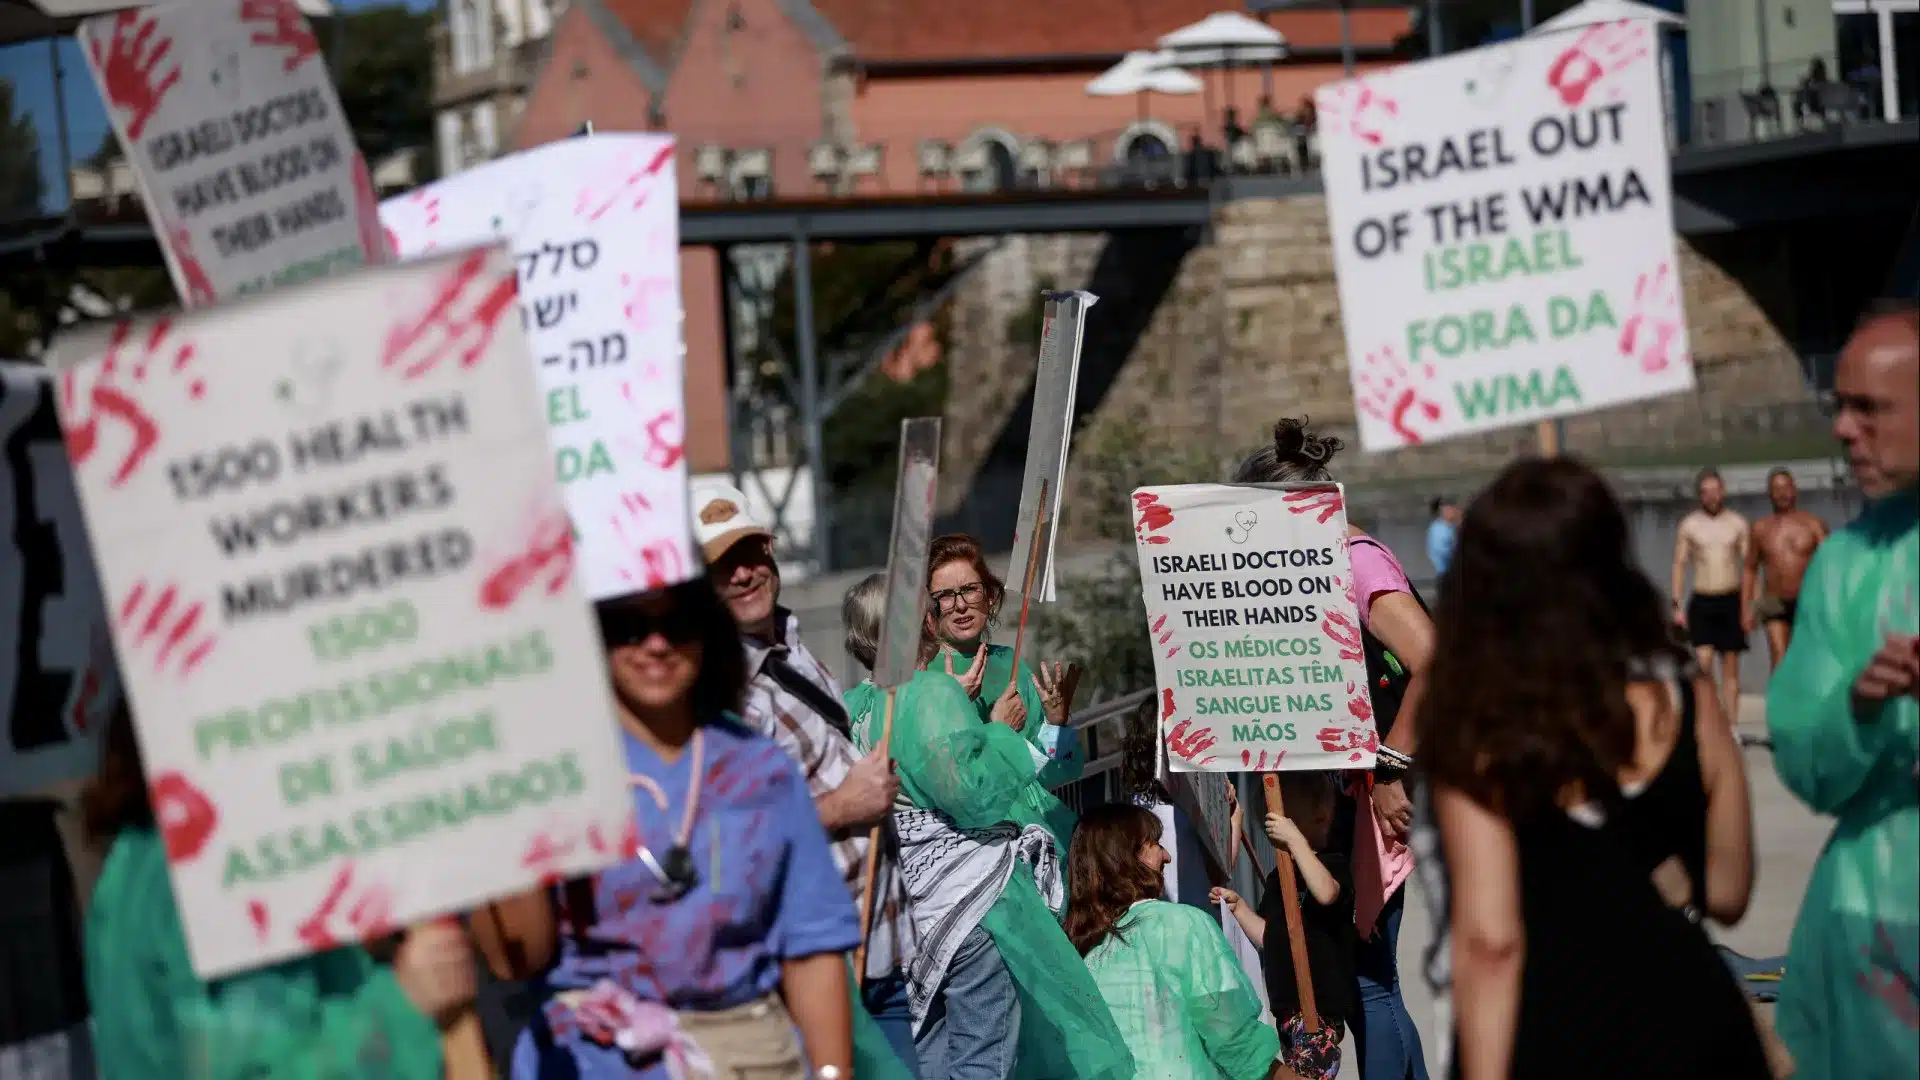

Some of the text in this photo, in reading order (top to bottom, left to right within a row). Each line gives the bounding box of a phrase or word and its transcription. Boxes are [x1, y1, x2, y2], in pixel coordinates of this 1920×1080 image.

[1360, 104, 1627, 192] ISRAEL OUT
[1353, 169, 1652, 260] OF THE WMA
[1423, 230, 1584, 293] ISRAEL
[1406, 291, 1617, 363] FORA DA
[1452, 366, 1583, 421] WMA
[165, 394, 471, 504] 1500 HEALTH
[555, 438, 616, 484] DA
[209, 465, 456, 558] WORKERS
[219, 527, 474, 624] MURDERED
[1153, 548, 1333, 574] ISRAELI DOCTORS
[1162, 576, 1331, 601] HAVE BLOOD ON
[306, 599, 420, 662] 1500
[1182, 605, 1317, 628] THEIR HANDS
[1177, 661, 1344, 688] ISRAELITAS TÊM
[1189, 634, 1321, 660] OS MÉDICOS
[192, 630, 555, 760] PROFISSIONAIS
[1195, 693, 1333, 715] SANGUE NAS
[1232, 719, 1297, 742] MÃOS
[277, 757, 335, 805] DE
[219, 752, 587, 889] ASSASSINADOS
